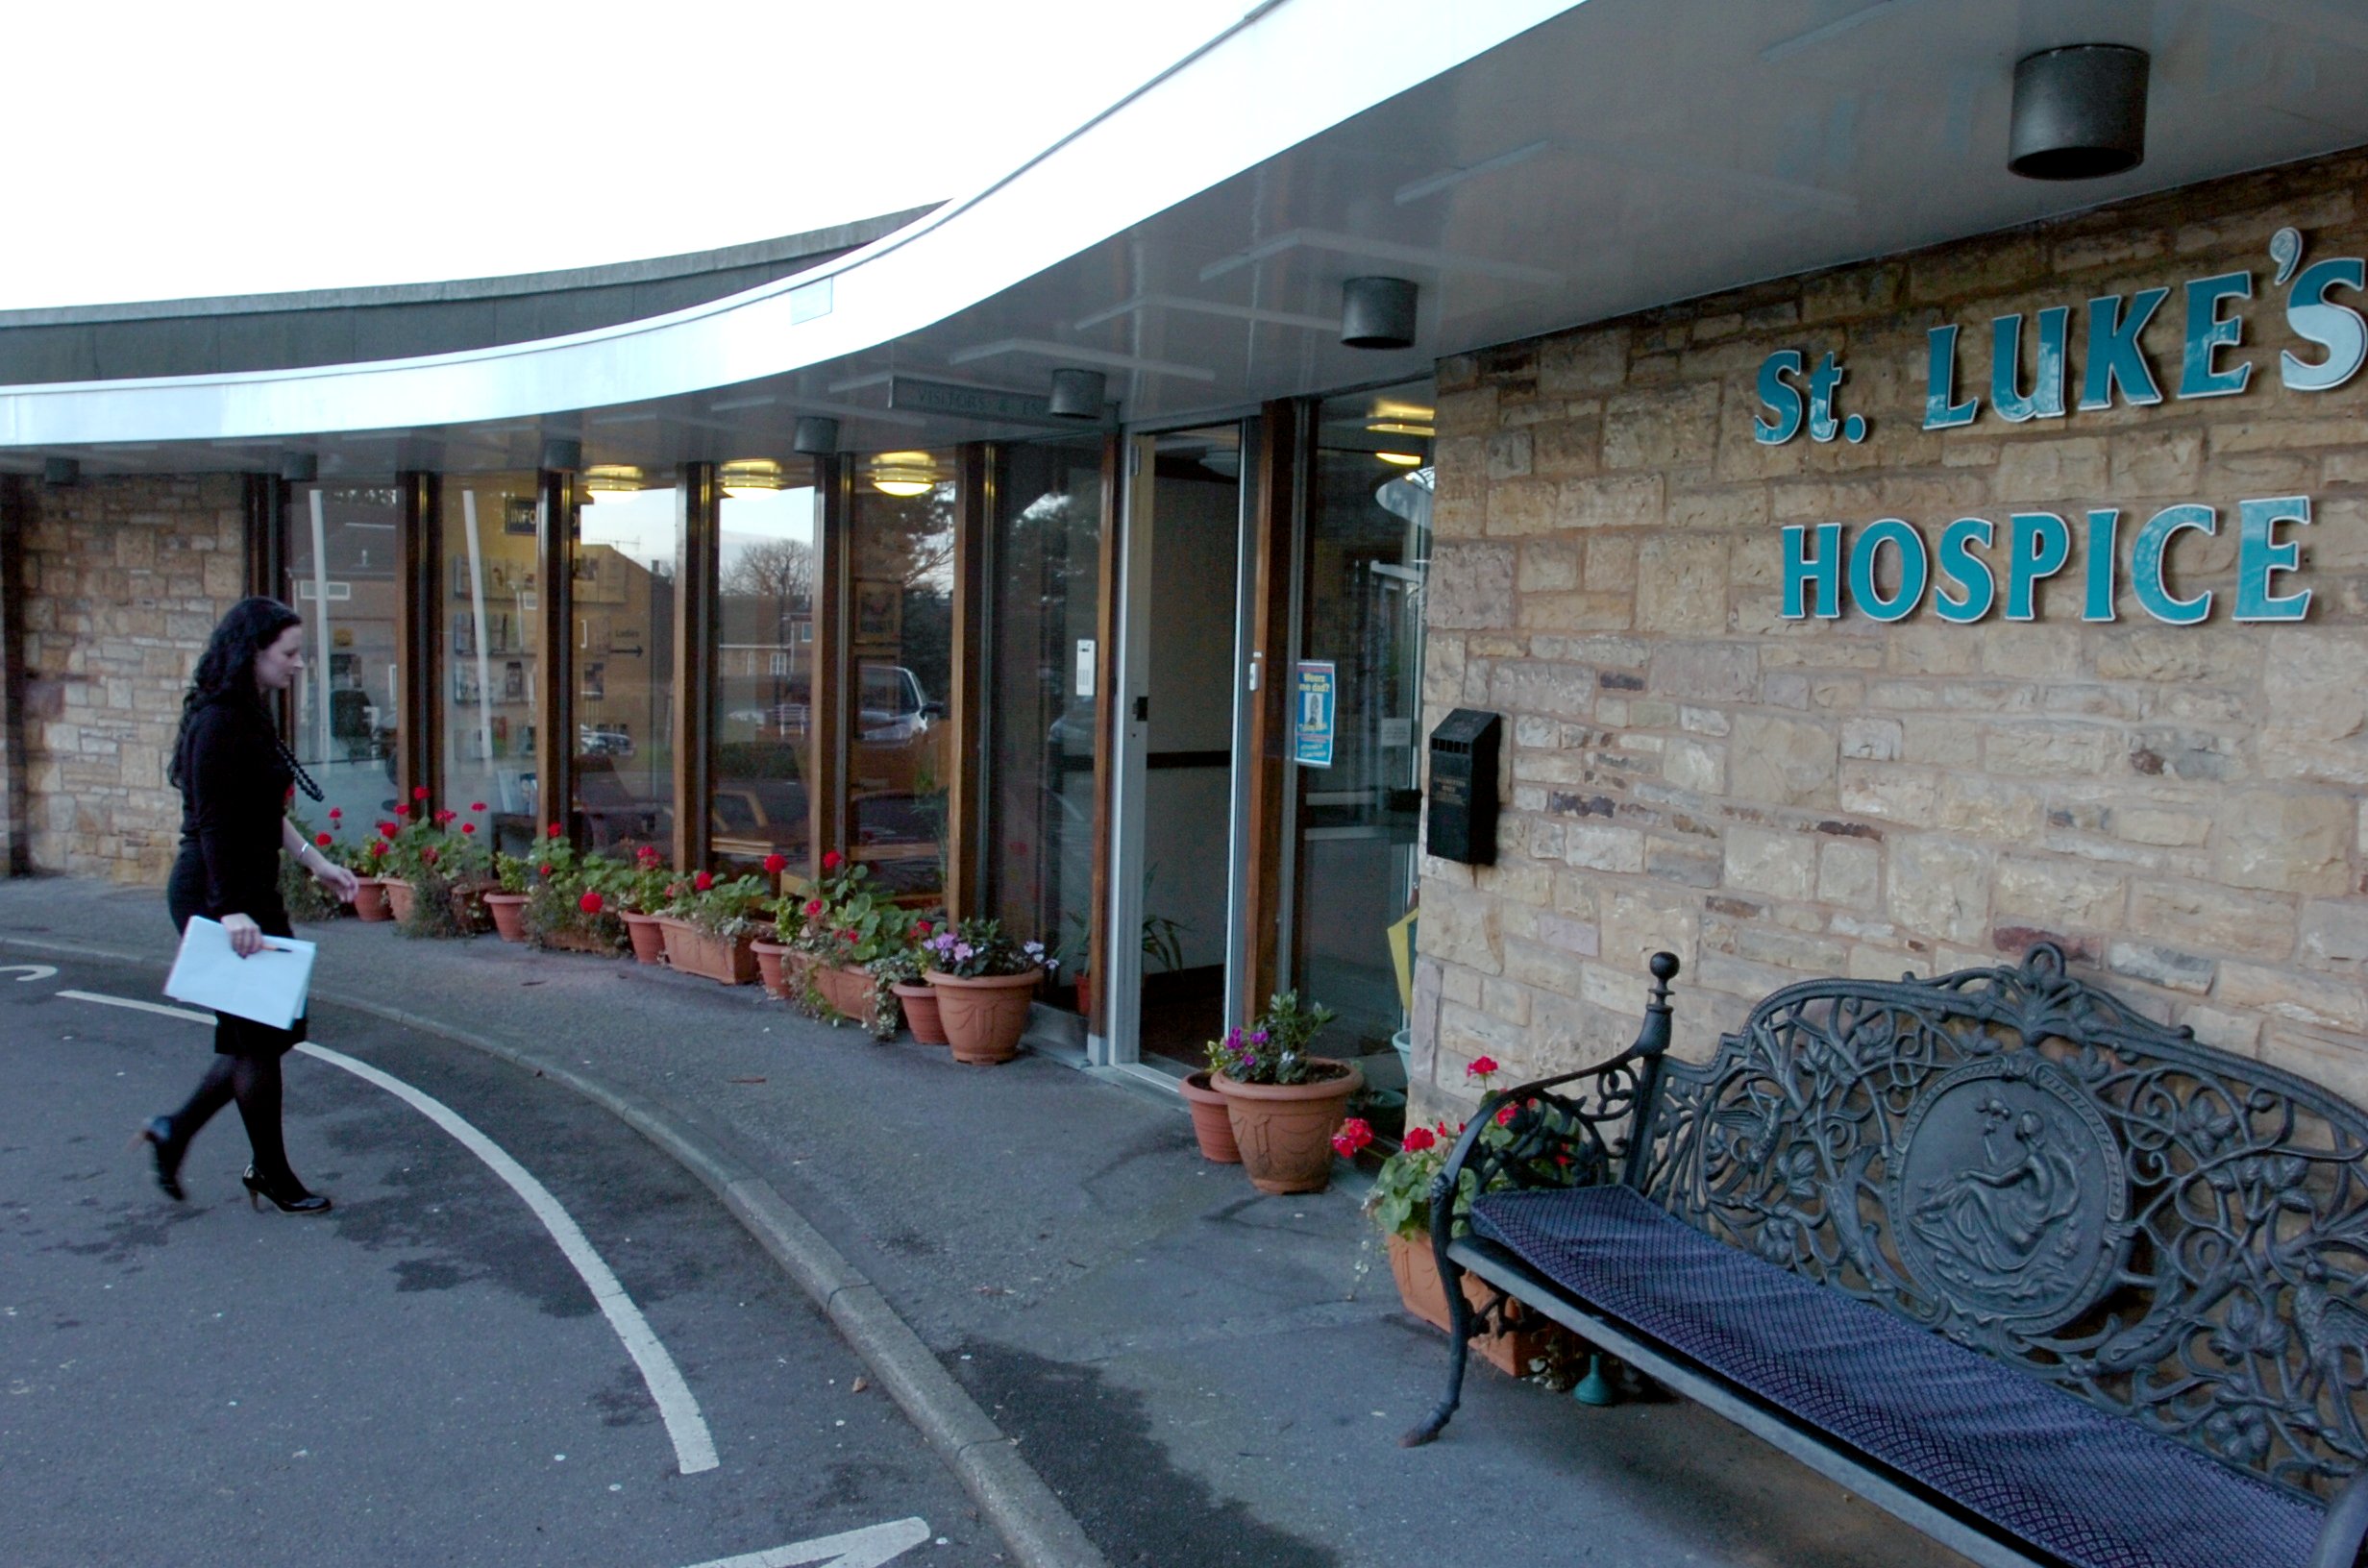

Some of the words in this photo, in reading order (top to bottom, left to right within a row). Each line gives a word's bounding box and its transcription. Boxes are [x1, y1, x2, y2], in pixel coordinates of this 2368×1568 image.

[1754, 349, 1866, 445] St.
[1922, 227, 2368, 429] LUKE'S
[1781, 496, 2311, 625] HOSPICE
